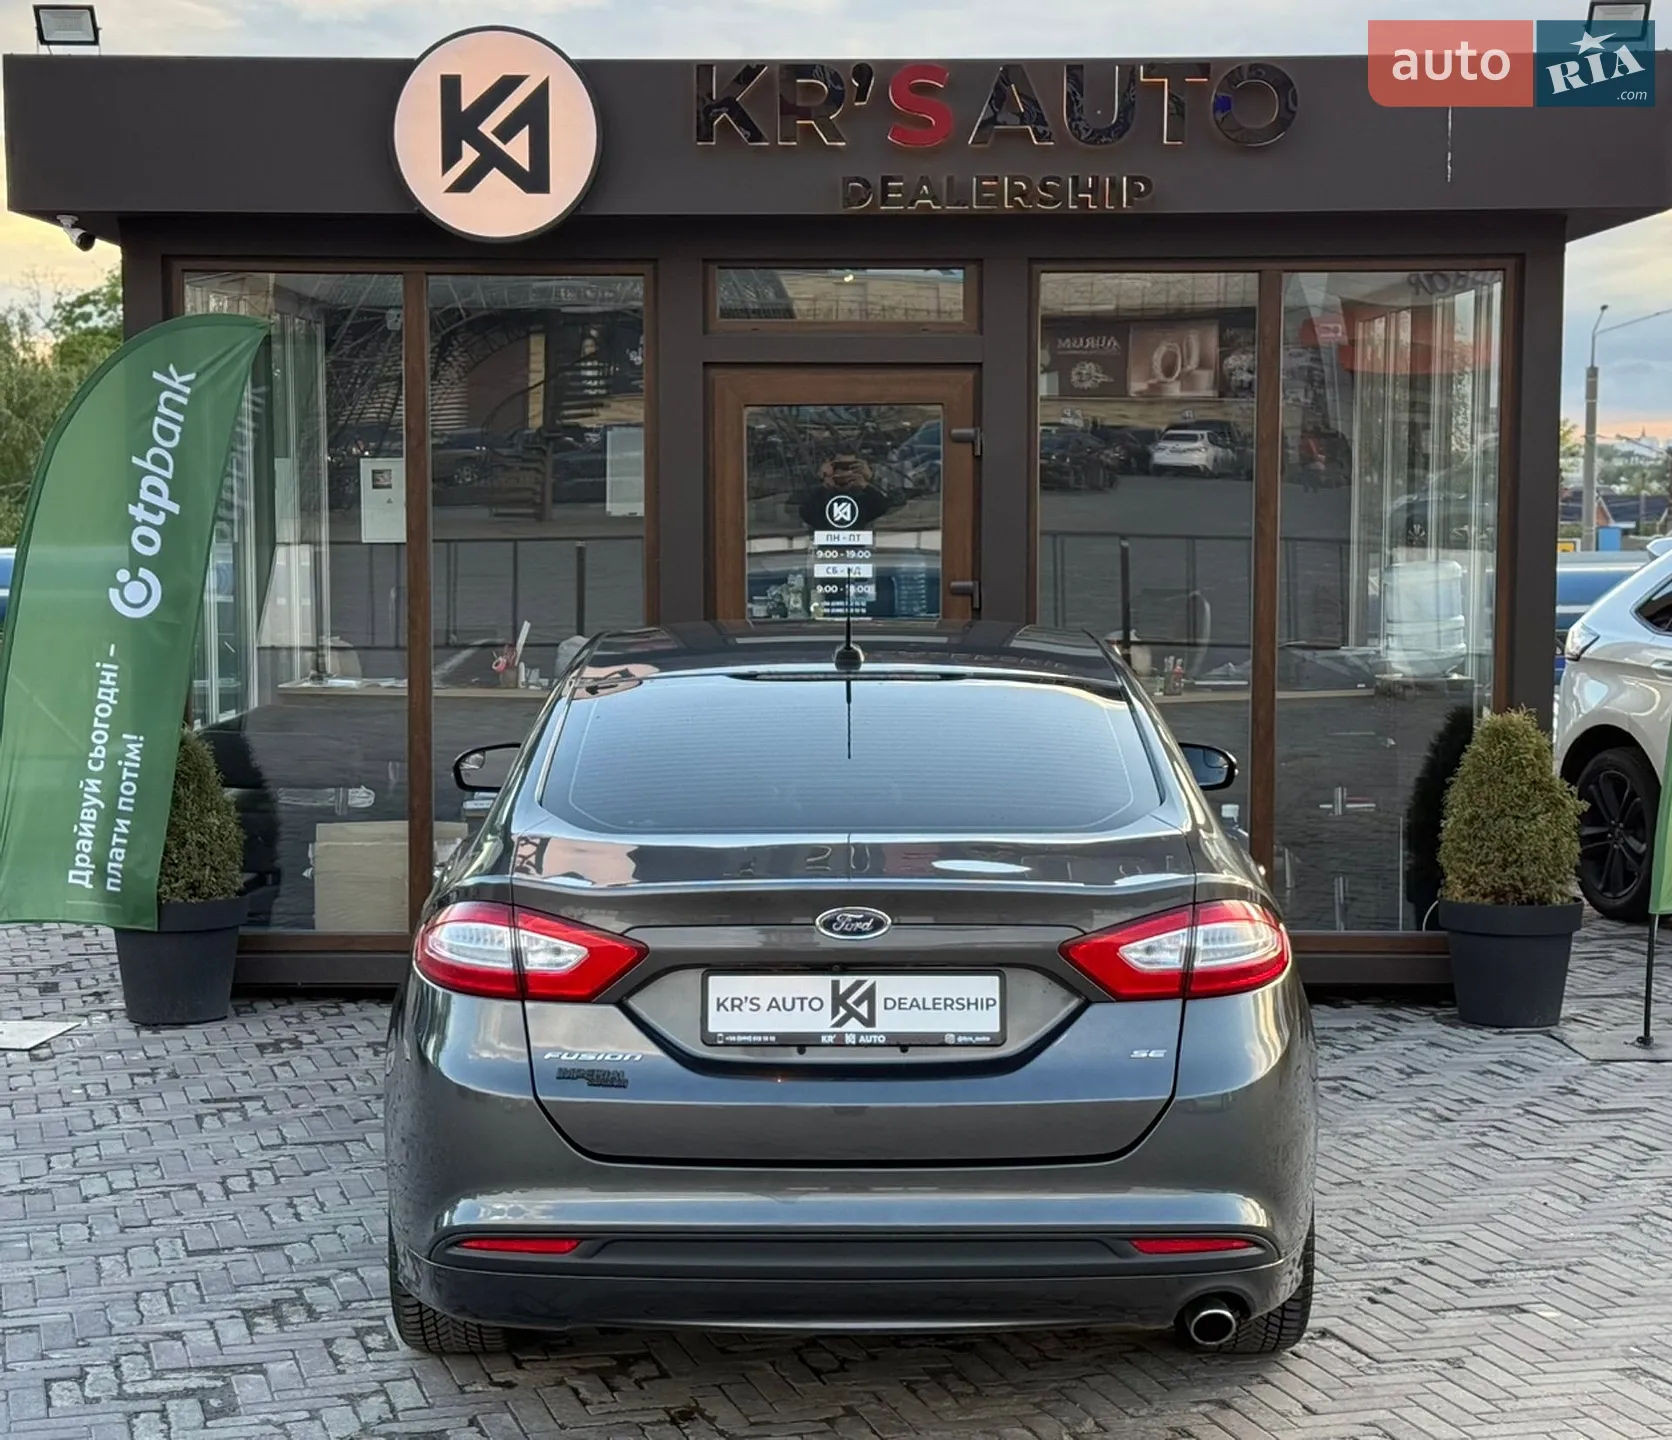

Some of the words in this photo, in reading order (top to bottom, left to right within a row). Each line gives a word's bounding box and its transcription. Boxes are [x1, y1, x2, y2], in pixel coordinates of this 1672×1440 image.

[695, 62, 954, 148] KR'S
[968, 62, 1299, 147] AUTO
[841, 174, 1155, 211] DEALERSHIP
[128, 363, 197, 557] otpbank
[826, 534, 840, 542] ПН
[849, 534, 861, 542] ПТ
[826, 566, 838, 575] СБ
[67, 778, 105, 890] Драйвуй
[86, 660, 120, 772] сьогодні
[117, 733, 145, 812] потім!
[105, 817, 132, 892] плати
[832, 913, 874, 932] Ford
[716, 996, 762, 1012] KR'S
[766, 996, 824, 1012] AUTO
[883, 997, 998, 1011] DEALERSHIP
[858, 1034, 886, 1043] AUTO
[543, 1051, 643, 1061] FUSION
[1130, 1049, 1167, 1059] SE
